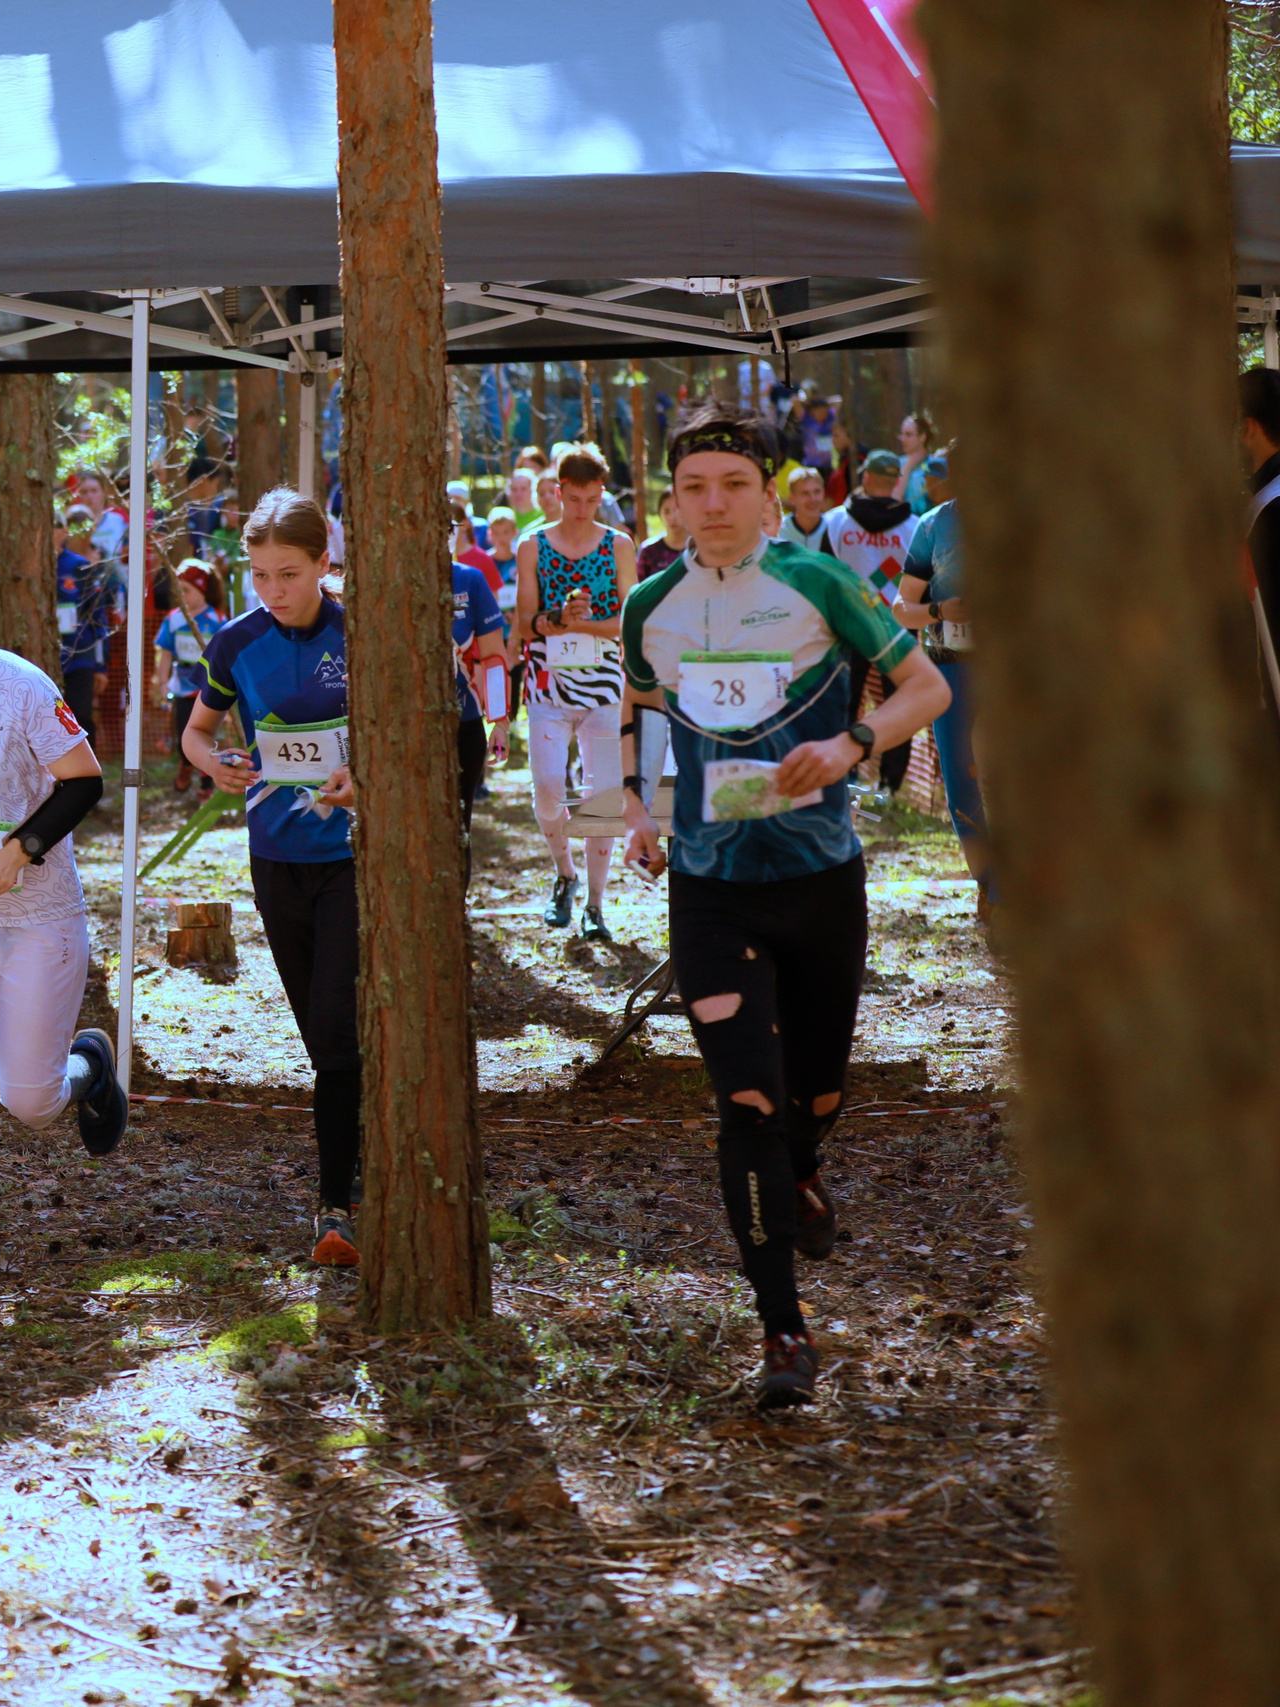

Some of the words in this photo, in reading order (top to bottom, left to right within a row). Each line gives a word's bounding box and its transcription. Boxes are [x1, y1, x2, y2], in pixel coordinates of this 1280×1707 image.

[843, 530, 902, 548] СУДЬЯ
[560, 641, 578, 655] 37
[710, 679, 746, 707] 28
[277, 742, 323, 762] 432
[748, 1171, 761, 1225] NORD
